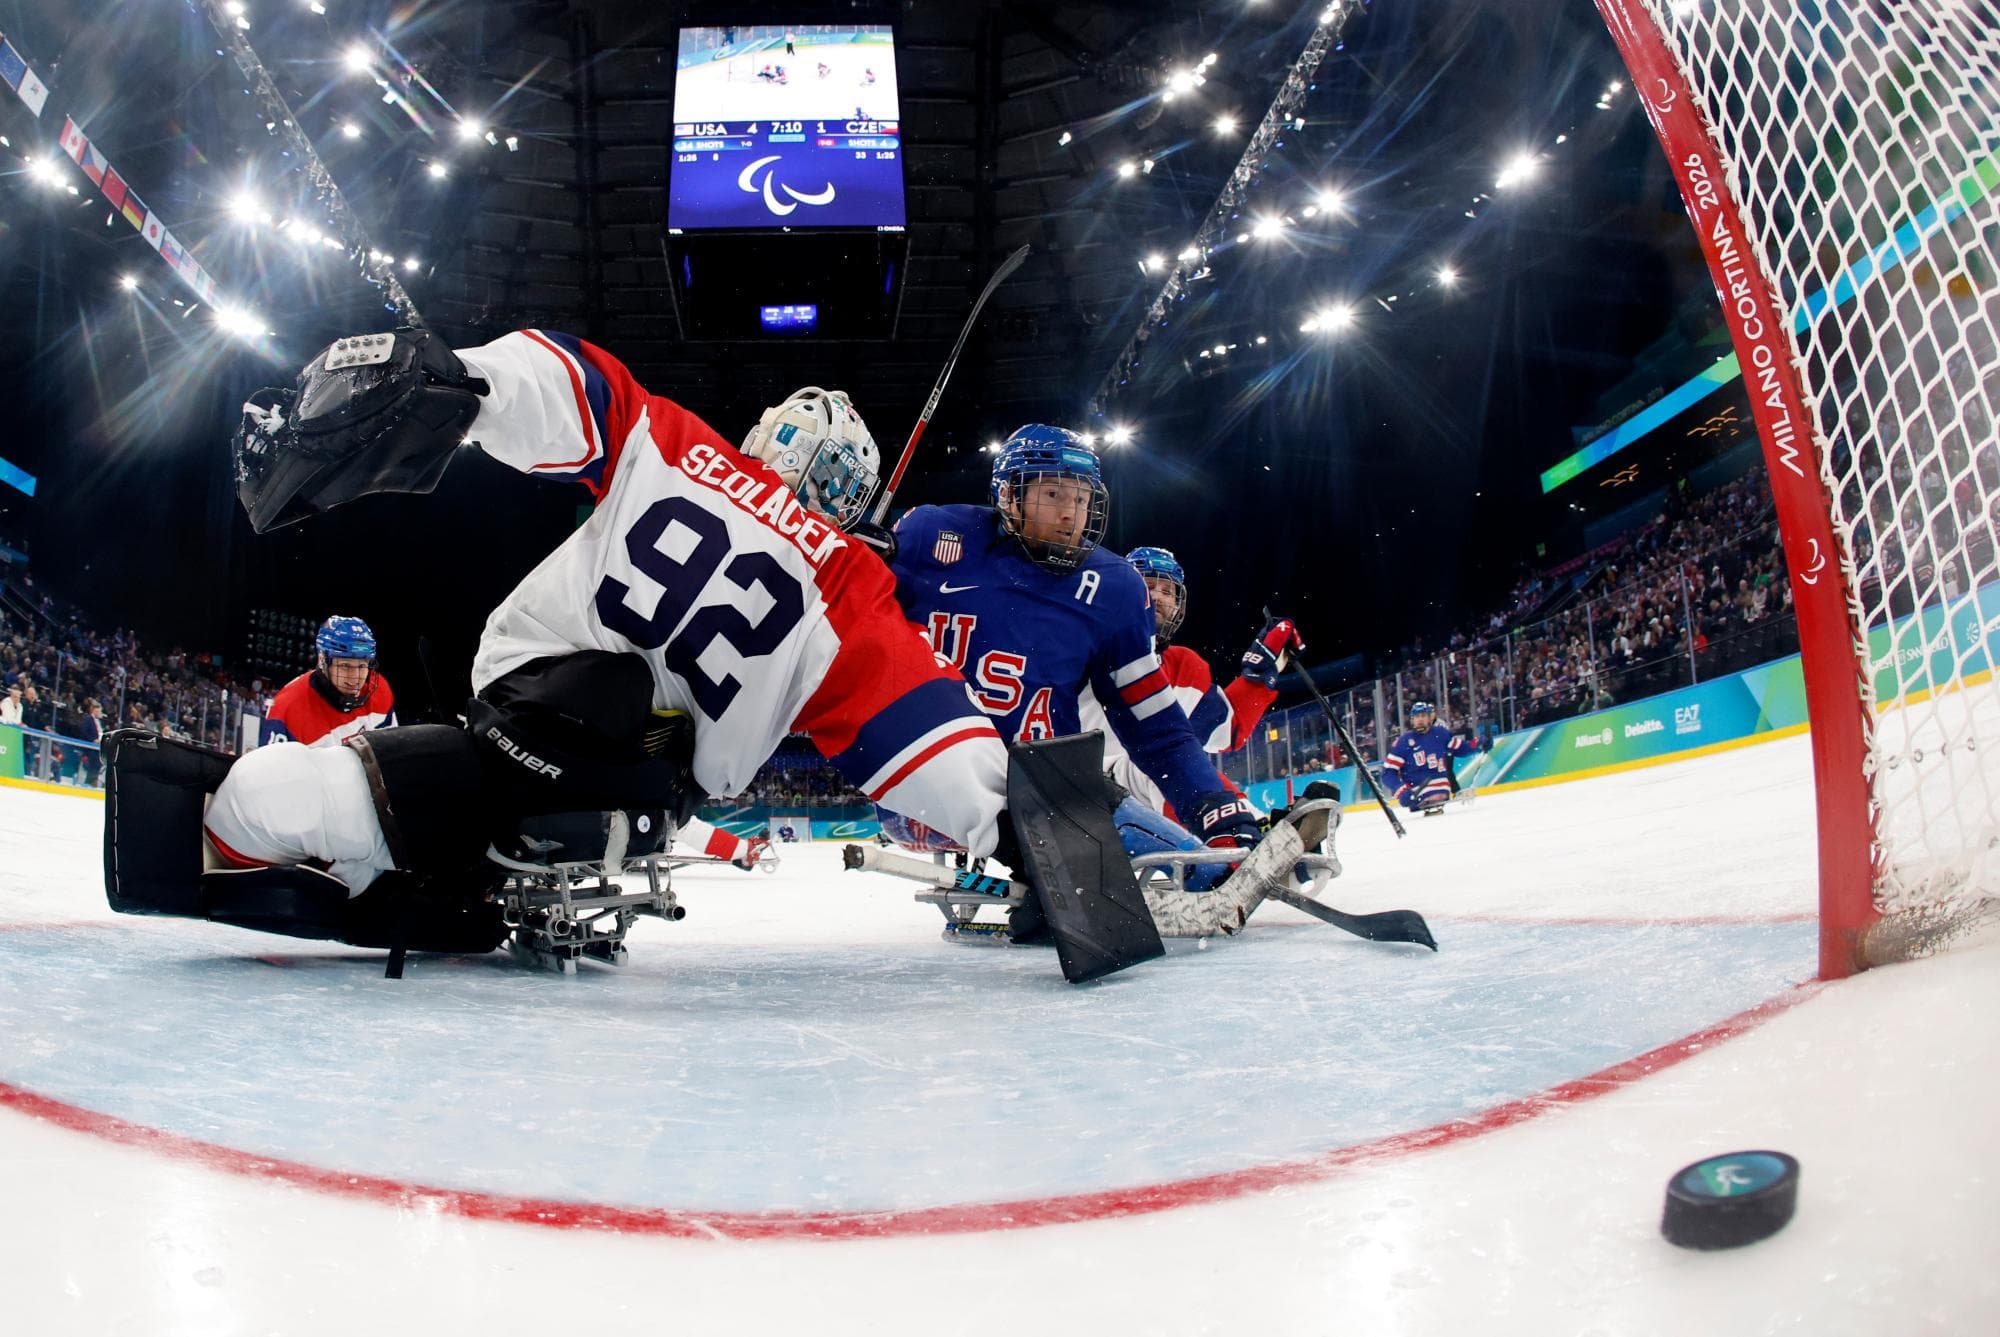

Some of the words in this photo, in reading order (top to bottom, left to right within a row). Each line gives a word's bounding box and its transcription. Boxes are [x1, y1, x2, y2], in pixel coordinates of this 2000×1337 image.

[695, 123, 728, 136] USA
[747, 122, 758, 134] 4
[771, 121, 803, 133] 7:10
[817, 121, 826, 133] 1
[845, 121, 878, 134] CZE
[696, 140, 725, 149] SHOTS
[1684, 154, 1719, 210] 2026
[1713, 211, 1764, 340] CORTINA
[1752, 344, 1804, 477] MILANO
[942, 533, 959, 542] USA
[1075, 569, 1101, 606] A
[595, 496, 805, 723] 92
[1675, 704, 1700, 724] EA7
